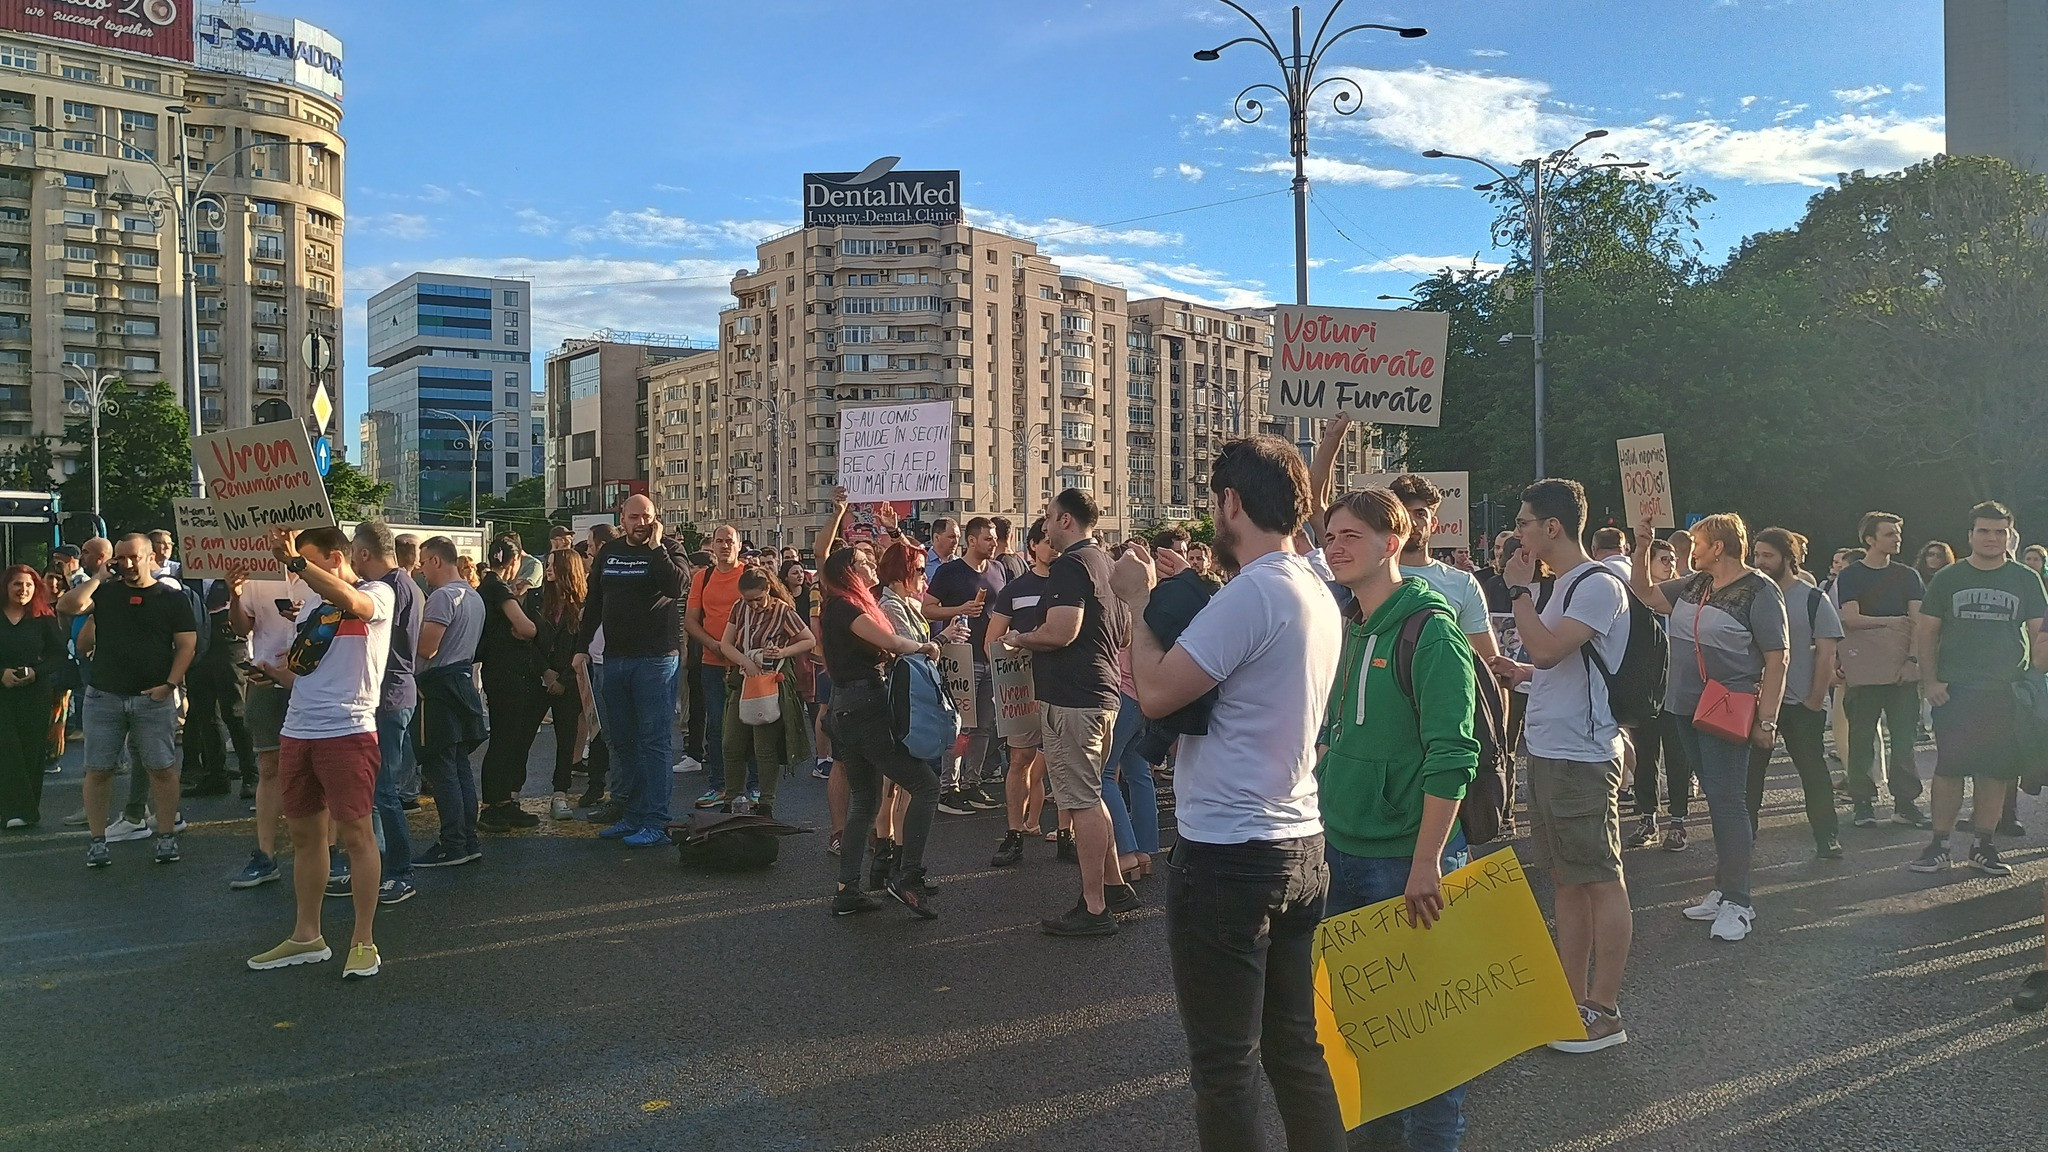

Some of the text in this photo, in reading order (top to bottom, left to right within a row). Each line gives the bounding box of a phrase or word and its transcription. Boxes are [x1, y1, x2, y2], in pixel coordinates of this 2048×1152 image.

[25, 6, 154, 38] we succeed together
[236, 26, 342, 80] SANADOR
[807, 181, 956, 208] DentalMed
[808, 208, 956, 225] Luxury Dental Clinic
[1283, 312, 1377, 343] Voturi
[1282, 343, 1434, 379] Numărate
[1281, 379, 1432, 414] NU Furate
[845, 411, 875, 430] S-AU
[844, 429, 890, 450] FRAUDE
[894, 425, 906, 444] ÎN
[211, 437, 298, 480] Vrem
[843, 455, 876, 474] B.E.C.
[901, 451, 937, 471] A.E.P.
[210, 471, 311, 500] Renumărare
[843, 476, 861, 494] NU
[890, 473, 912, 493] FAC
[915, 471, 947, 492] NIMIC
[179, 506, 206, 516] M-am
[224, 510, 248, 531] Nu
[248, 500, 324, 528] Fraudare
[201, 536, 225, 550] am
[185, 552, 203, 570] la
[999, 684, 1029, 704] Vrem
[1318, 857, 1524, 957] ĂRĂ FRDARE
[1337, 954, 1535, 1058] RENUMĂRARE
